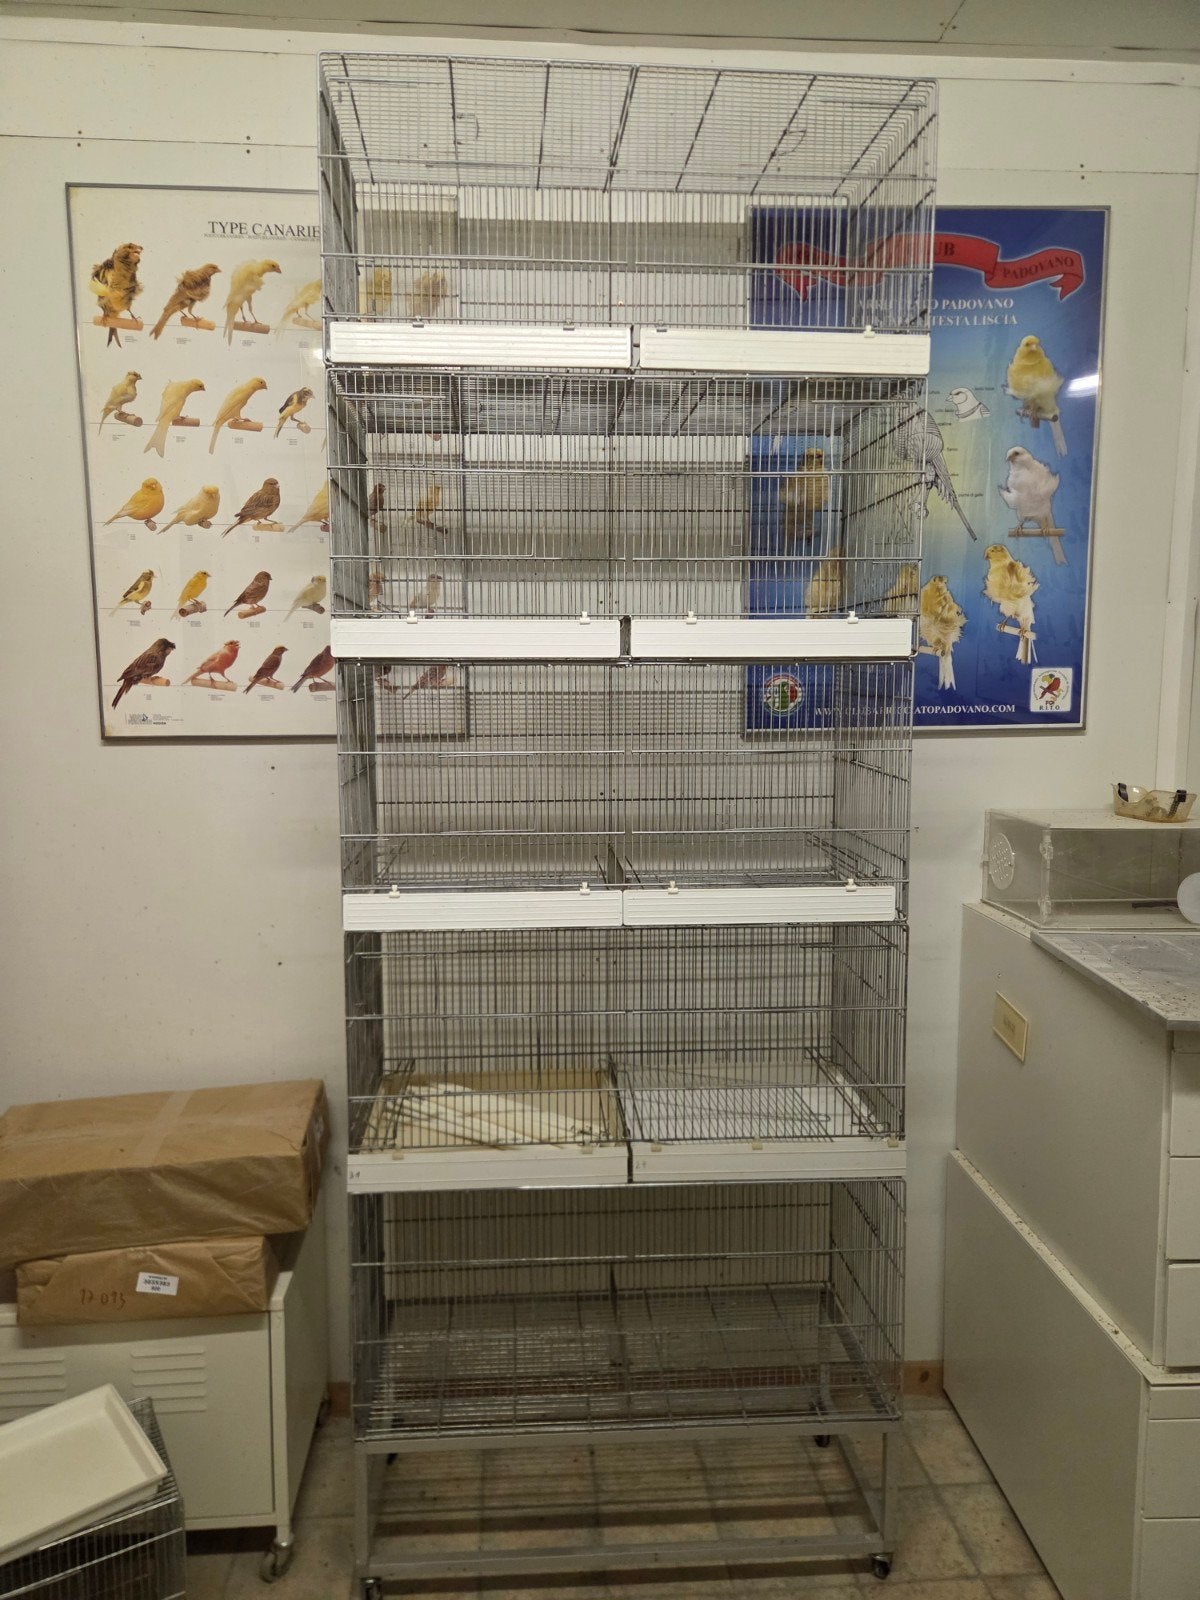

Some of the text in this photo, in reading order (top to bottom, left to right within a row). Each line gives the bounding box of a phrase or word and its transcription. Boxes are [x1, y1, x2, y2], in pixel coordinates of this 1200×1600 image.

[208, 221, 248, 234] TYPE
[1002, 256, 1075, 281] PADOVANO
[942, 298, 1014, 310] PADOVANO
[973, 314, 1018, 325] LISCIA
